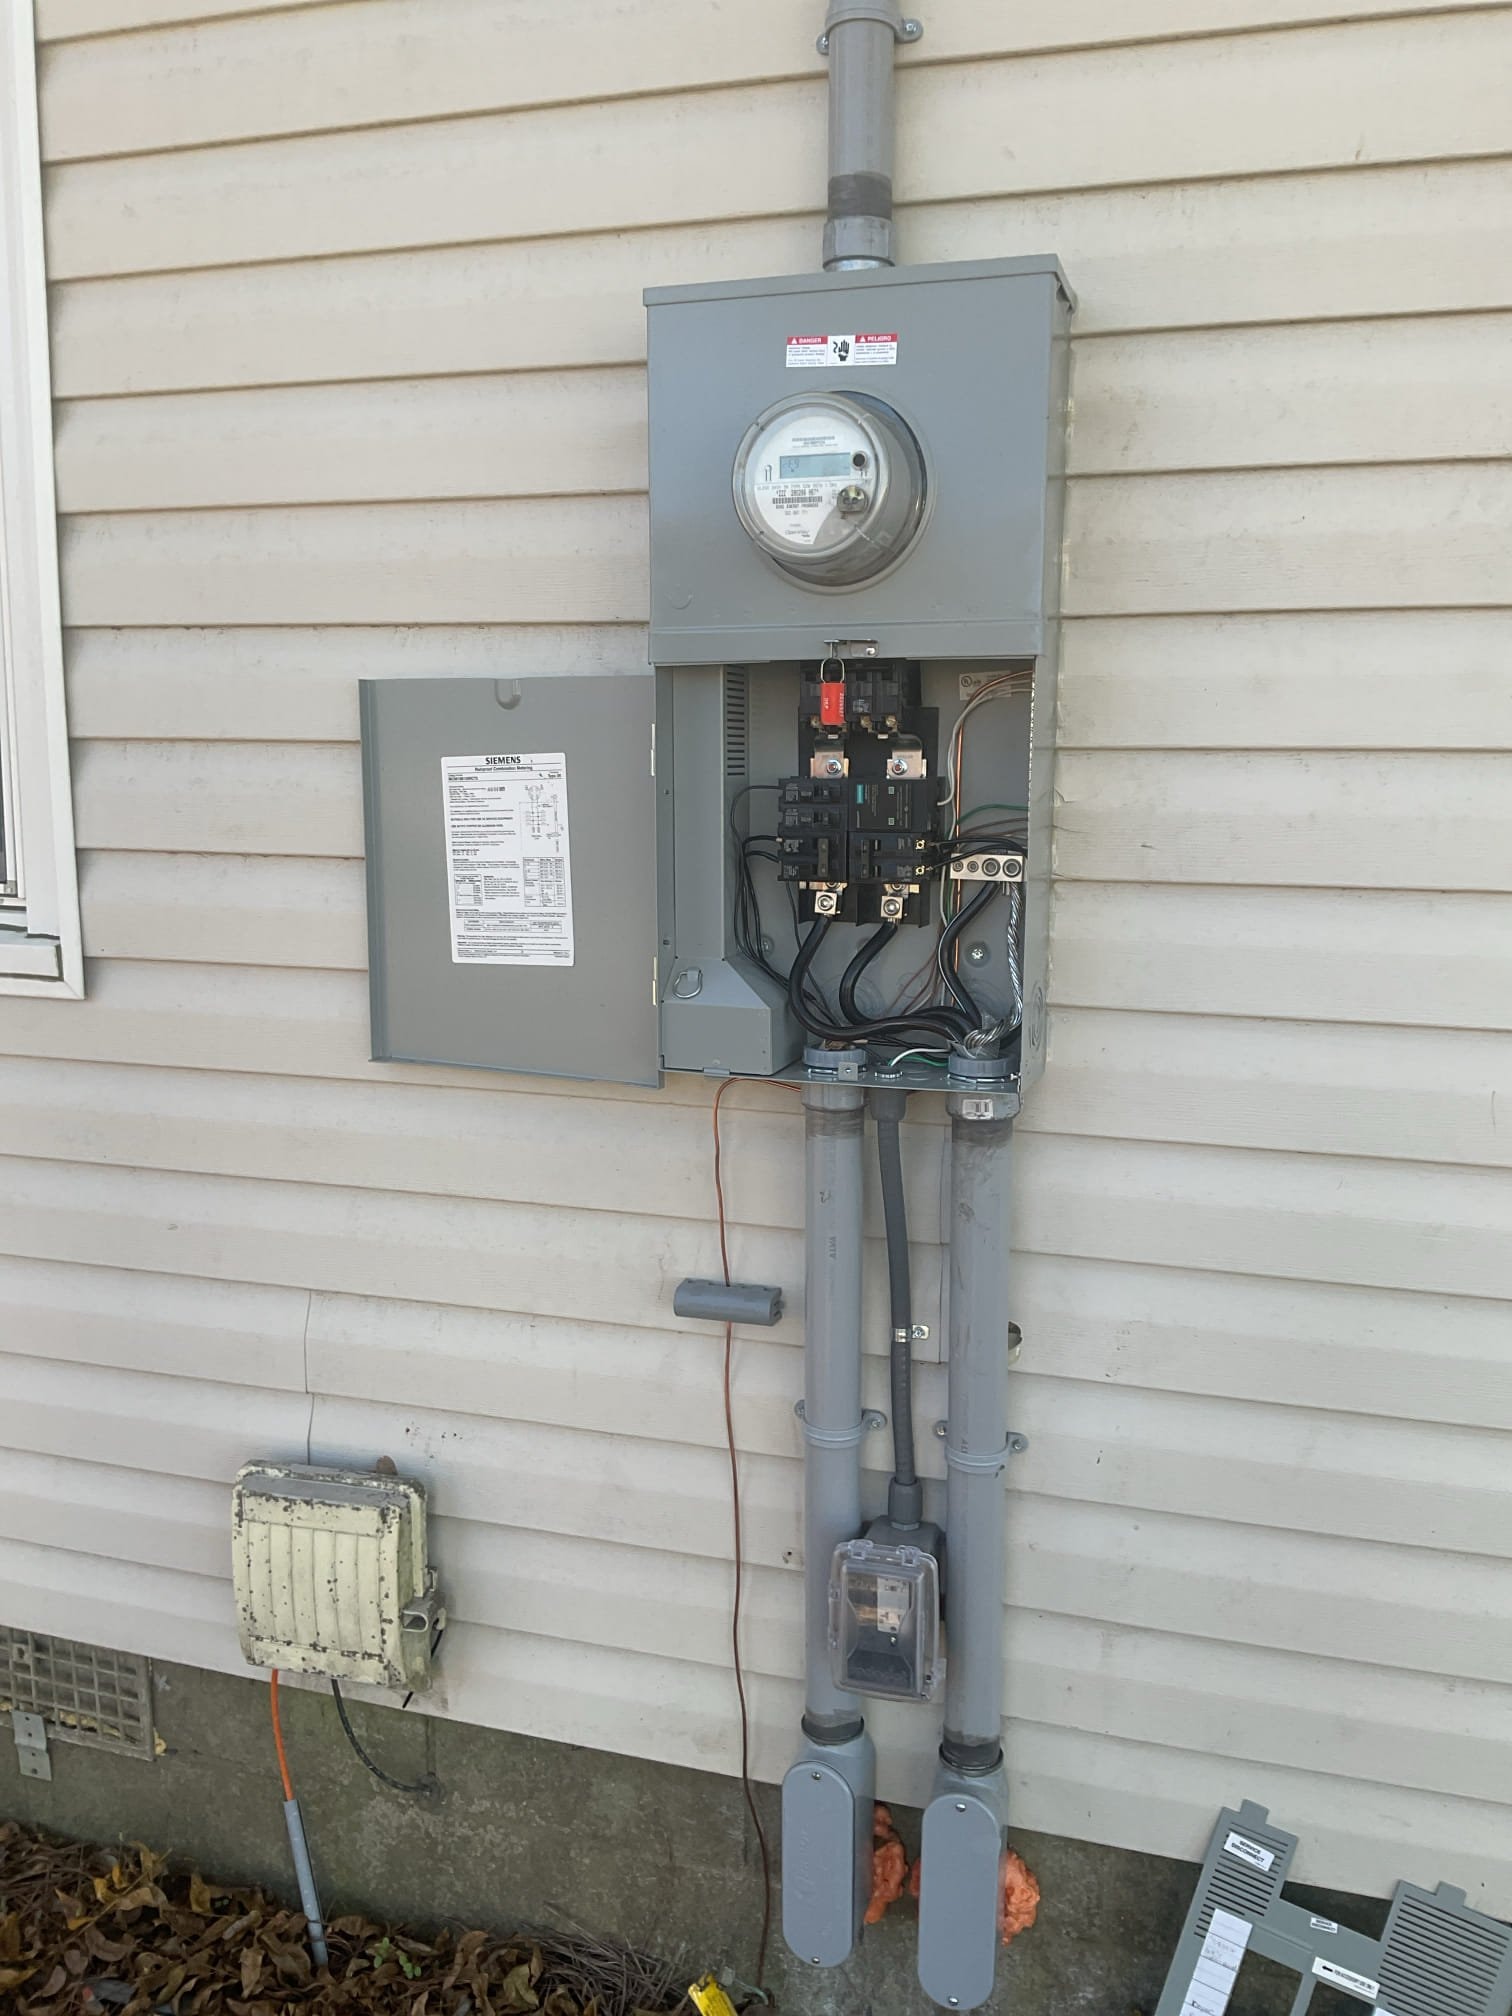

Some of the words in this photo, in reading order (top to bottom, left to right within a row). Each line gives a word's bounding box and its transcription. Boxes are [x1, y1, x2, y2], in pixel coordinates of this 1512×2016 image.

[485, 756, 521, 765] SIEMENS
[1231, 1842, 1265, 1862] DISCONNECT
[1239, 1840, 1261, 1854] SERVICE
